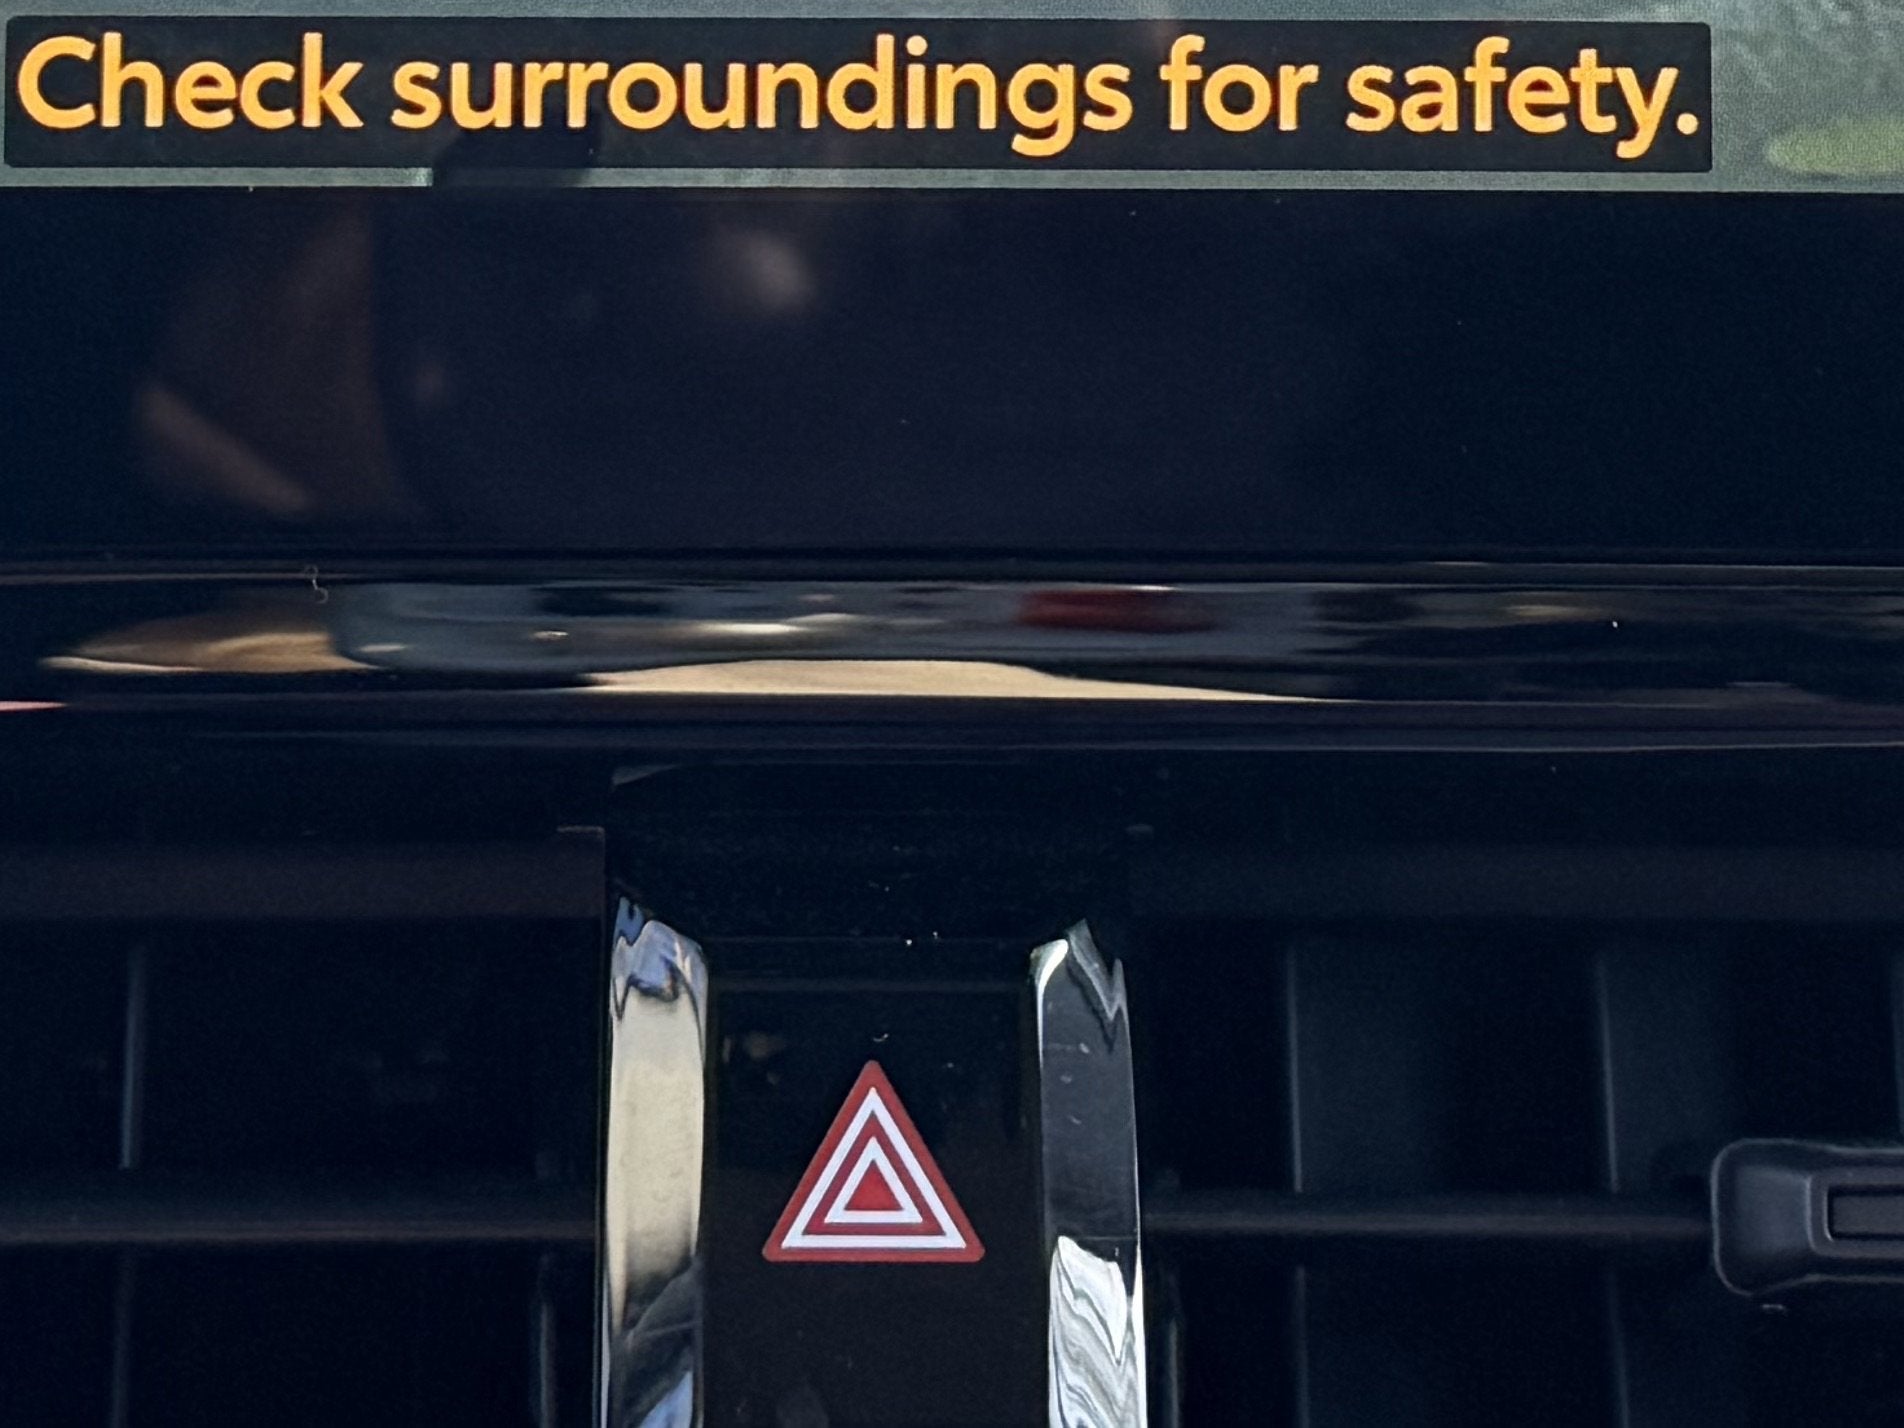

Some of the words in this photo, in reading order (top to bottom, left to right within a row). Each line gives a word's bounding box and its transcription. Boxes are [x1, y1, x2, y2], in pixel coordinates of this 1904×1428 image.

[16, 32, 363, 131] Check
[391, 33, 1134, 158] surroundings
[1158, 33, 1320, 133] for
[1346, 34, 1700, 160] safety.
